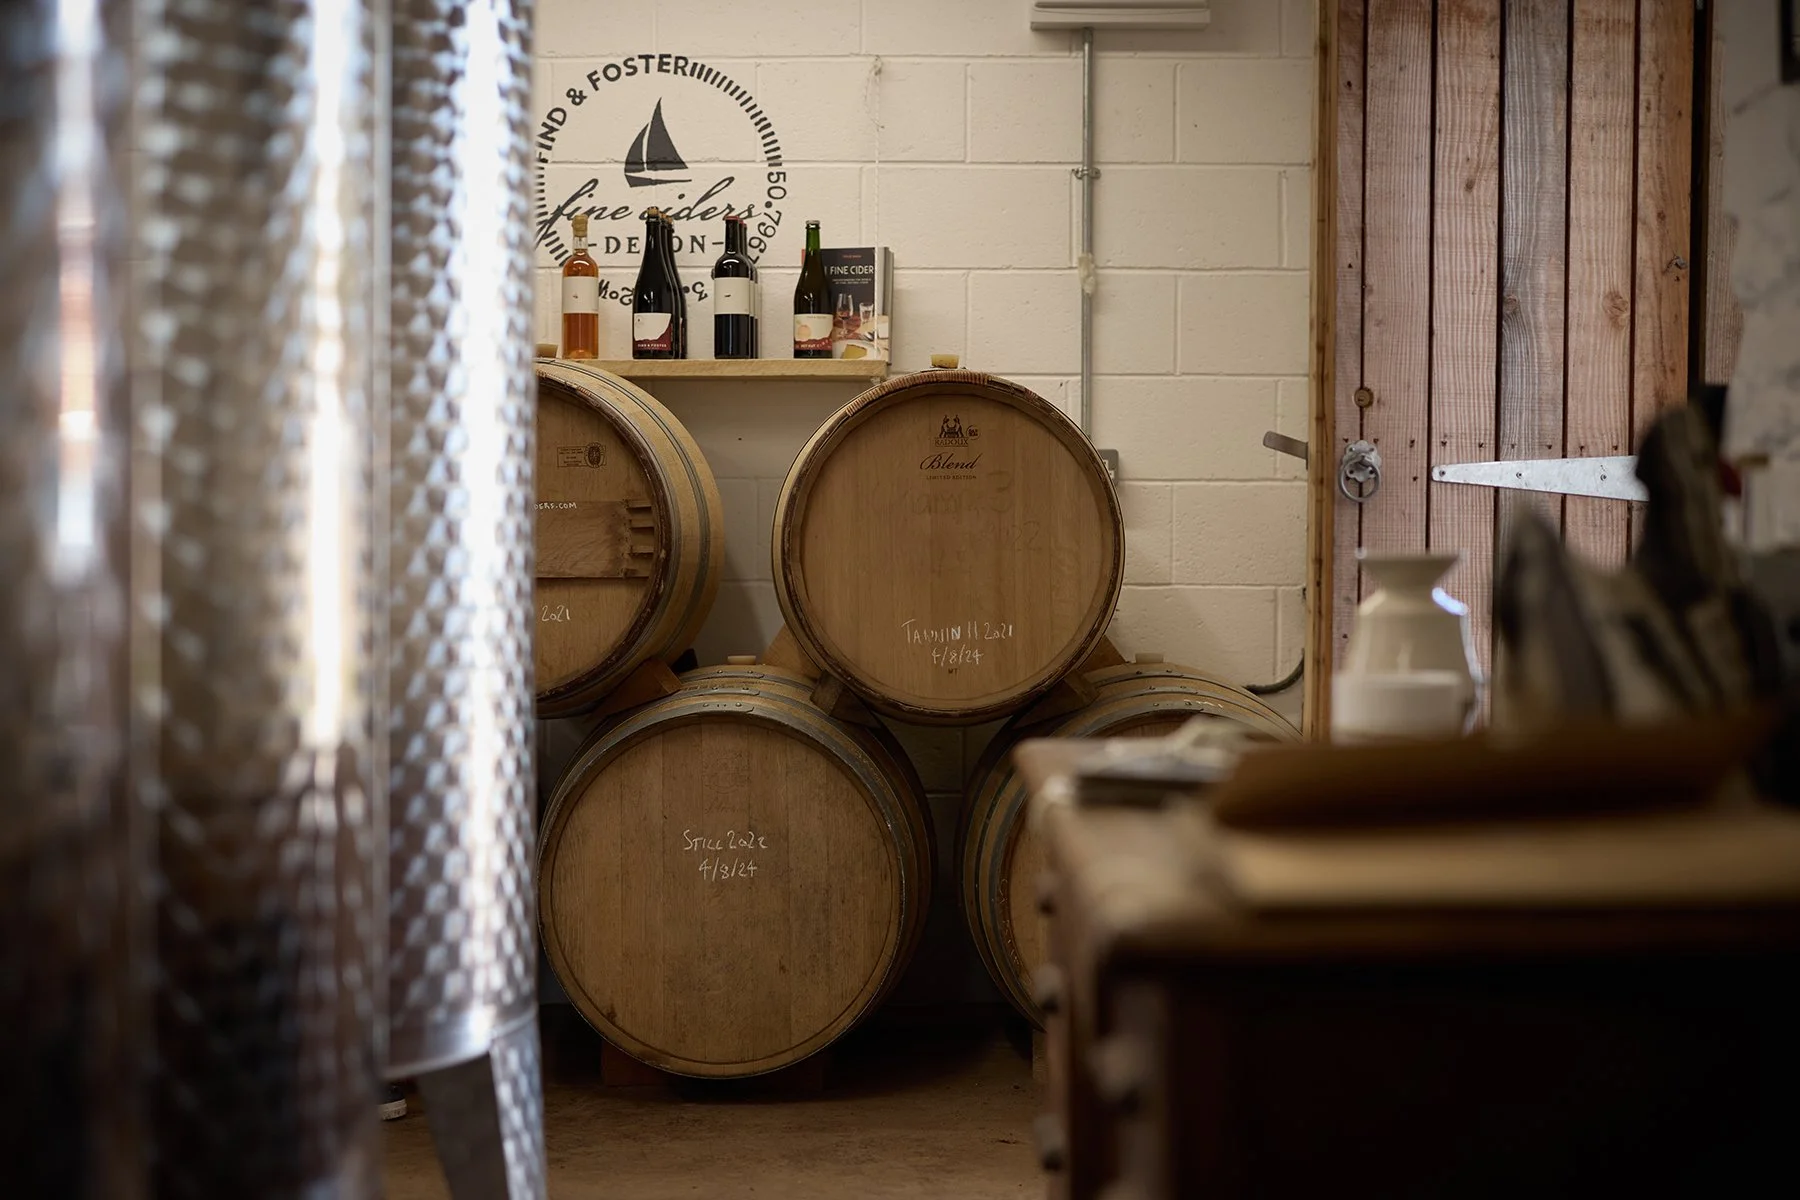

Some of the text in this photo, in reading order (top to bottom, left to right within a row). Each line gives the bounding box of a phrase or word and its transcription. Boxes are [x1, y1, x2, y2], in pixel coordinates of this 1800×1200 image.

[534, 53, 689, 164] FIND & FOSTER
[604, 234, 707, 254] DEON
[830, 265, 849, 275] FINE
[850, 264, 875, 275] CIDER
[919, 451, 984, 470] Blend
[541, 605, 571, 622] 2021
[983, 622, 1013, 640] 2021
[931, 643, 984, 667] 4/8/24
[683, 829, 769, 851] STILL 2022
[698, 857, 758, 881] 4/8/24
